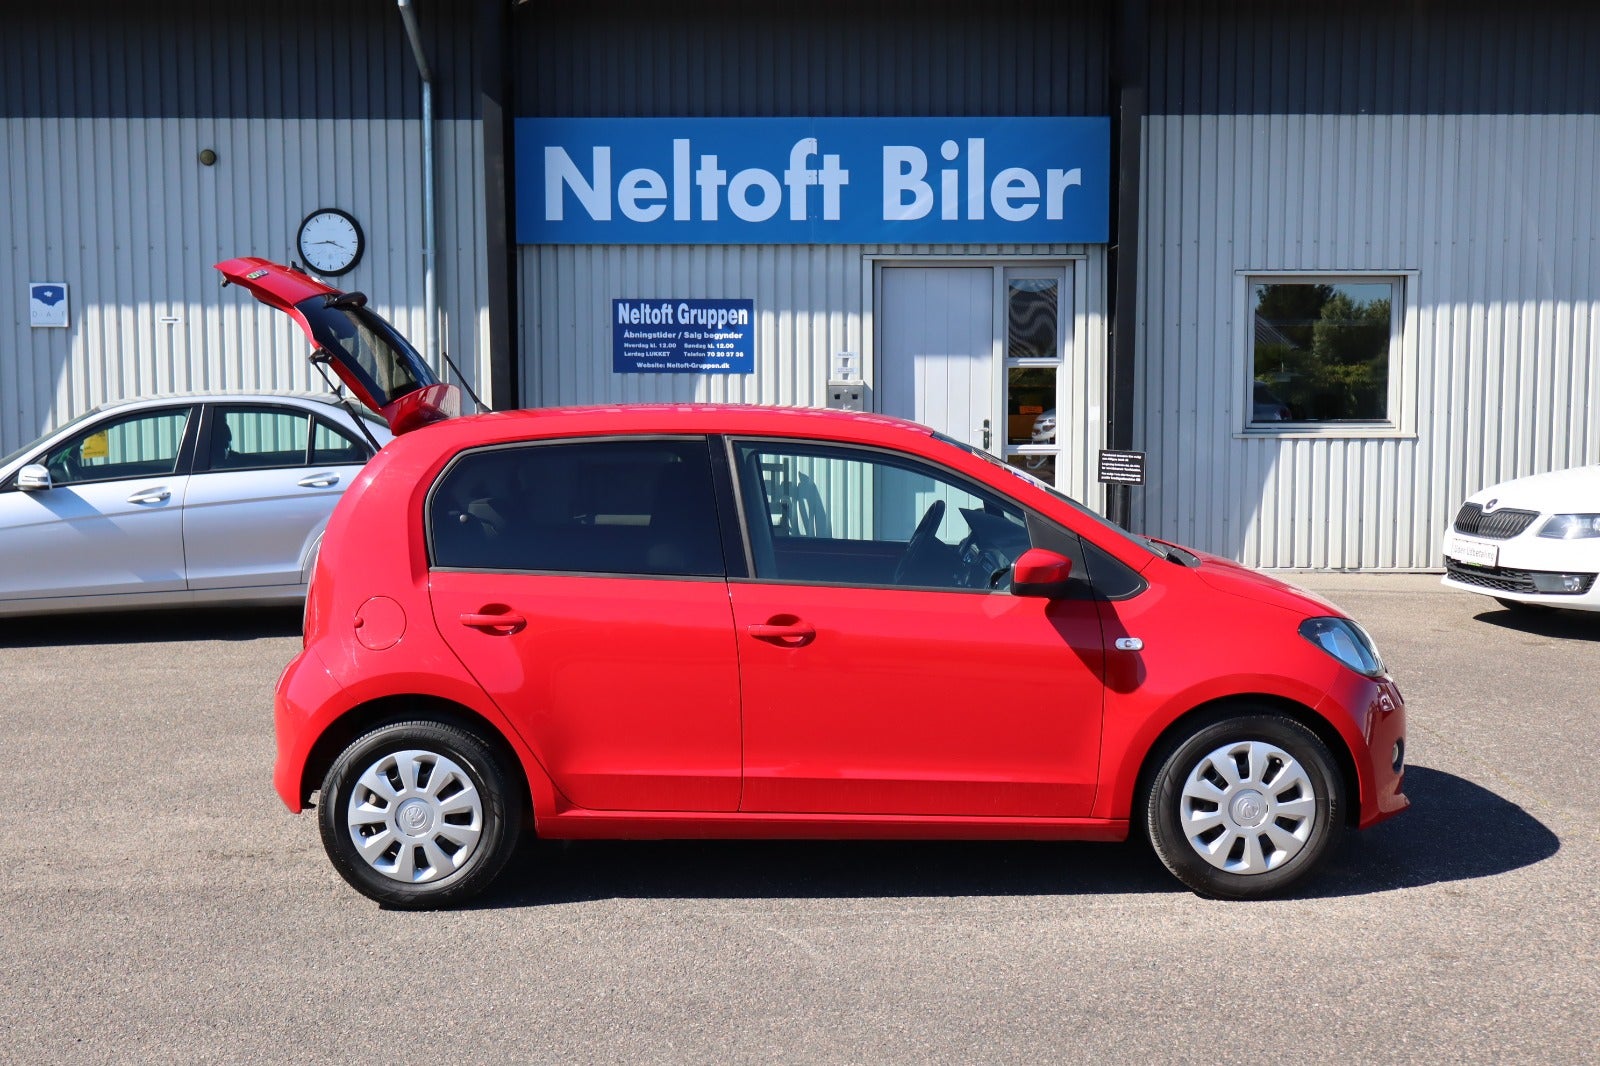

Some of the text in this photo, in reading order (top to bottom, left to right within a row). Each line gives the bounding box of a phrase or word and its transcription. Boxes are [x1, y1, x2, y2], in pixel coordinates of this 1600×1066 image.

[544, 138, 1081, 222] Neltoft Biler
[618, 302, 748, 329] Neltoft Gruppen
[623, 329, 676, 340] Åbningstider
[683, 331, 702, 340] Salg
[703, 331, 743, 340] begynder
